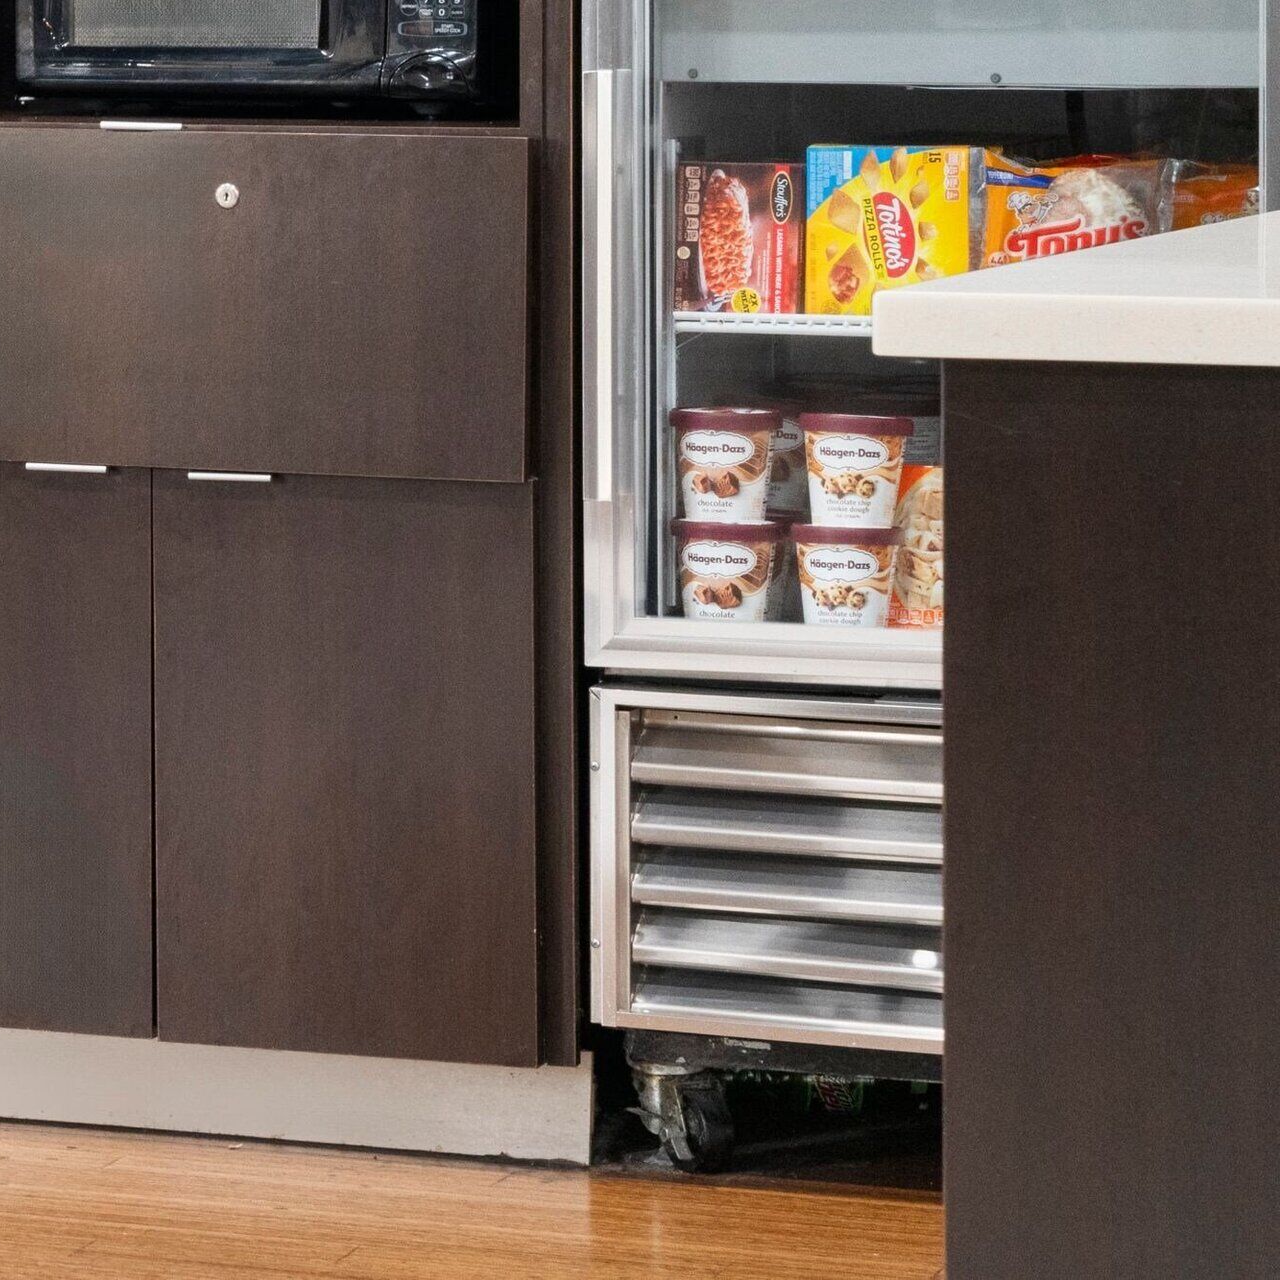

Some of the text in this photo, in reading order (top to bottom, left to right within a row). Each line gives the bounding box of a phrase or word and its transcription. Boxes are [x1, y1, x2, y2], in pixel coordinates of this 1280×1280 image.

[438, 8, 446, 17] 0
[774, 176, 789, 219] Stouffer's
[863, 197, 883, 272] PIZZA ROLLS
[875, 196, 907, 271] Totino's
[685, 441, 746, 456] Häagen-Dazs
[819, 446, 882, 461] Häagen-Dazs
[697, 499, 733, 509] chocolate
[687, 552, 749, 566] Häagen-Dazs
[809, 558, 871, 572] Häagen-Dazs
[698, 610, 736, 619] chocolate
